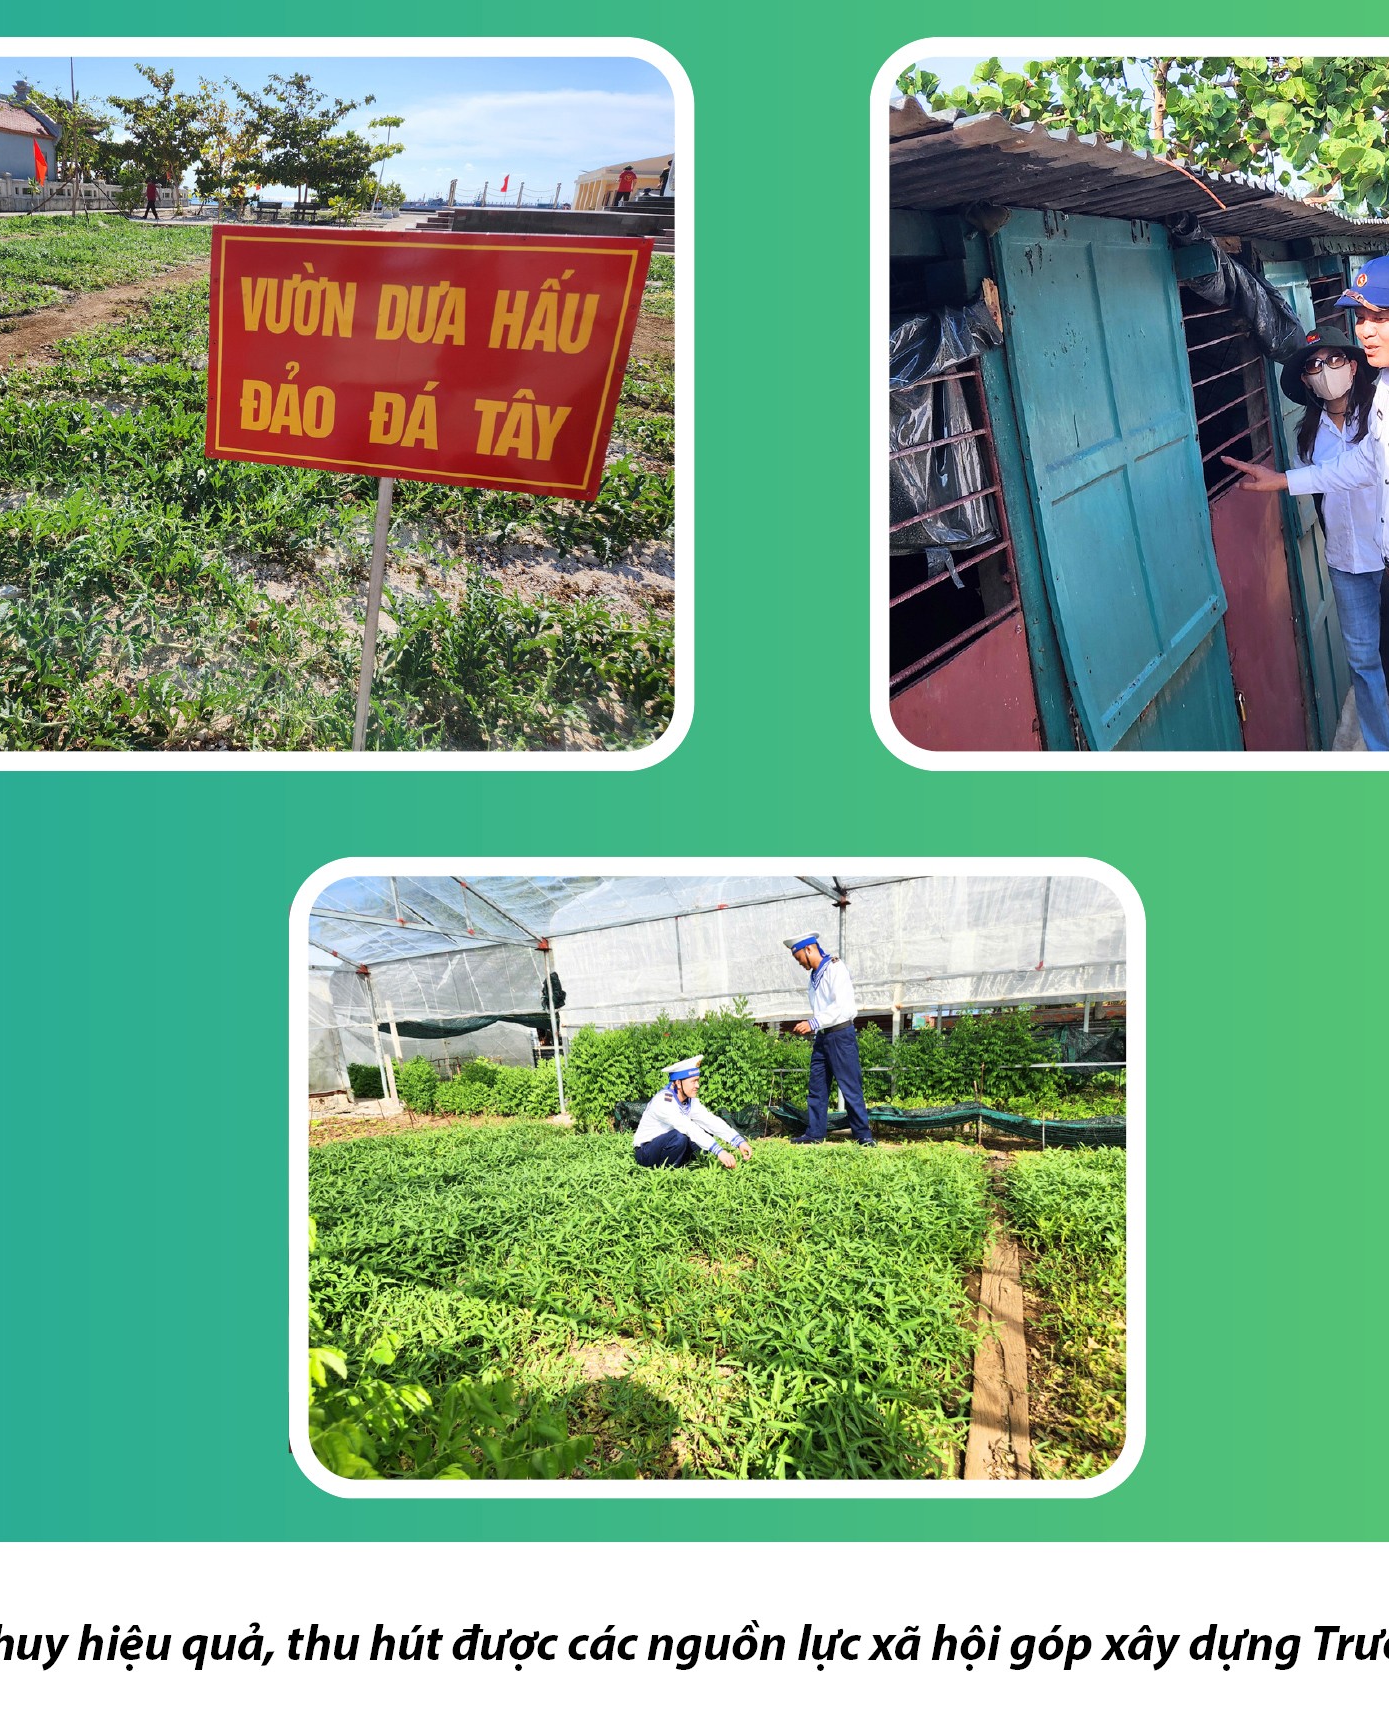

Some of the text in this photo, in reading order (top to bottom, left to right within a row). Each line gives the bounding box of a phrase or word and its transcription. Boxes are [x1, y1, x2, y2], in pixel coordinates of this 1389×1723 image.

[240, 262, 601, 355] VƯỜN DƯA HẤU
[239, 360, 572, 461] ĐẢO ĐÁ TÂY
